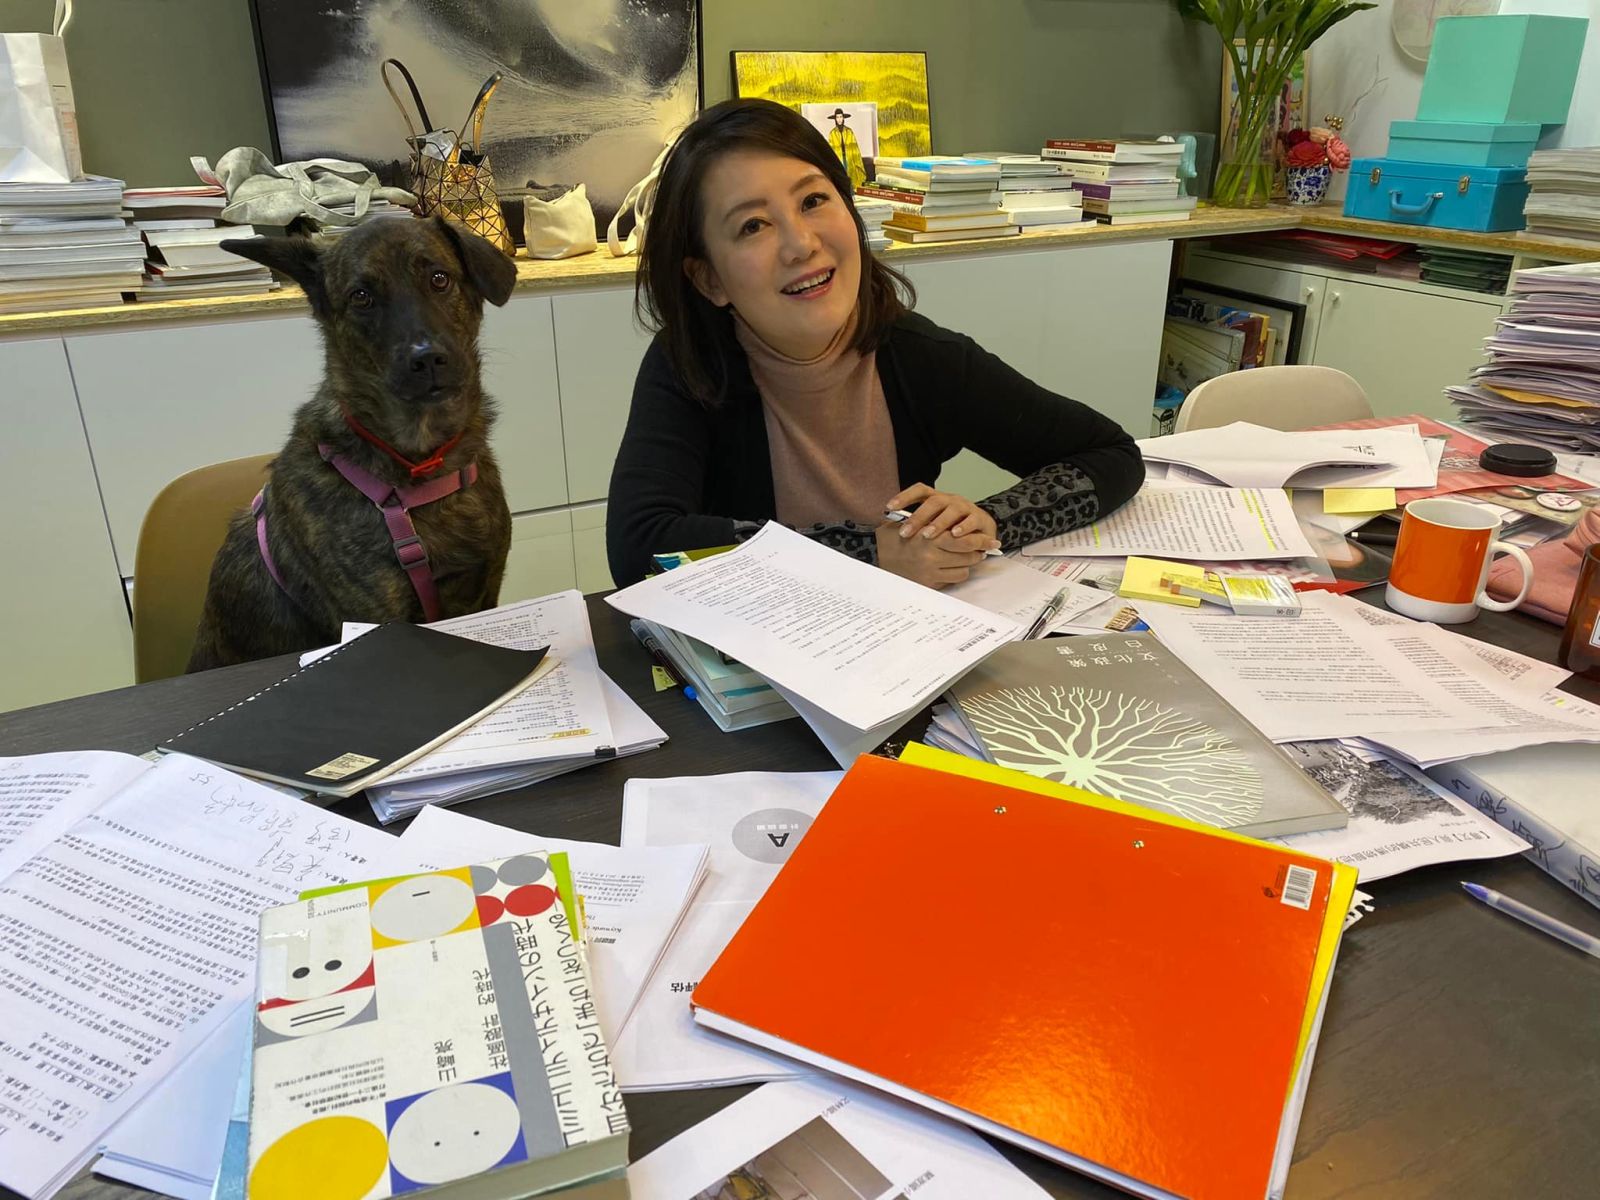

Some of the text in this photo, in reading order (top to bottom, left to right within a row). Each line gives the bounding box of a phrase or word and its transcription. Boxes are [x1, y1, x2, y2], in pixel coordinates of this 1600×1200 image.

[1056, 639, 1142, 654] 白皮書
[1066, 651, 1158, 667] 文化政策
[767, 833, 790, 847] A
[315, 901, 368, 917] COMMUNITY
[472, 967, 507, 1070] 社區設計 的時代
[509, 917, 588, 1148] コミュニティデザインの時代
[433, 1038, 457, 1083] 山崎亮
